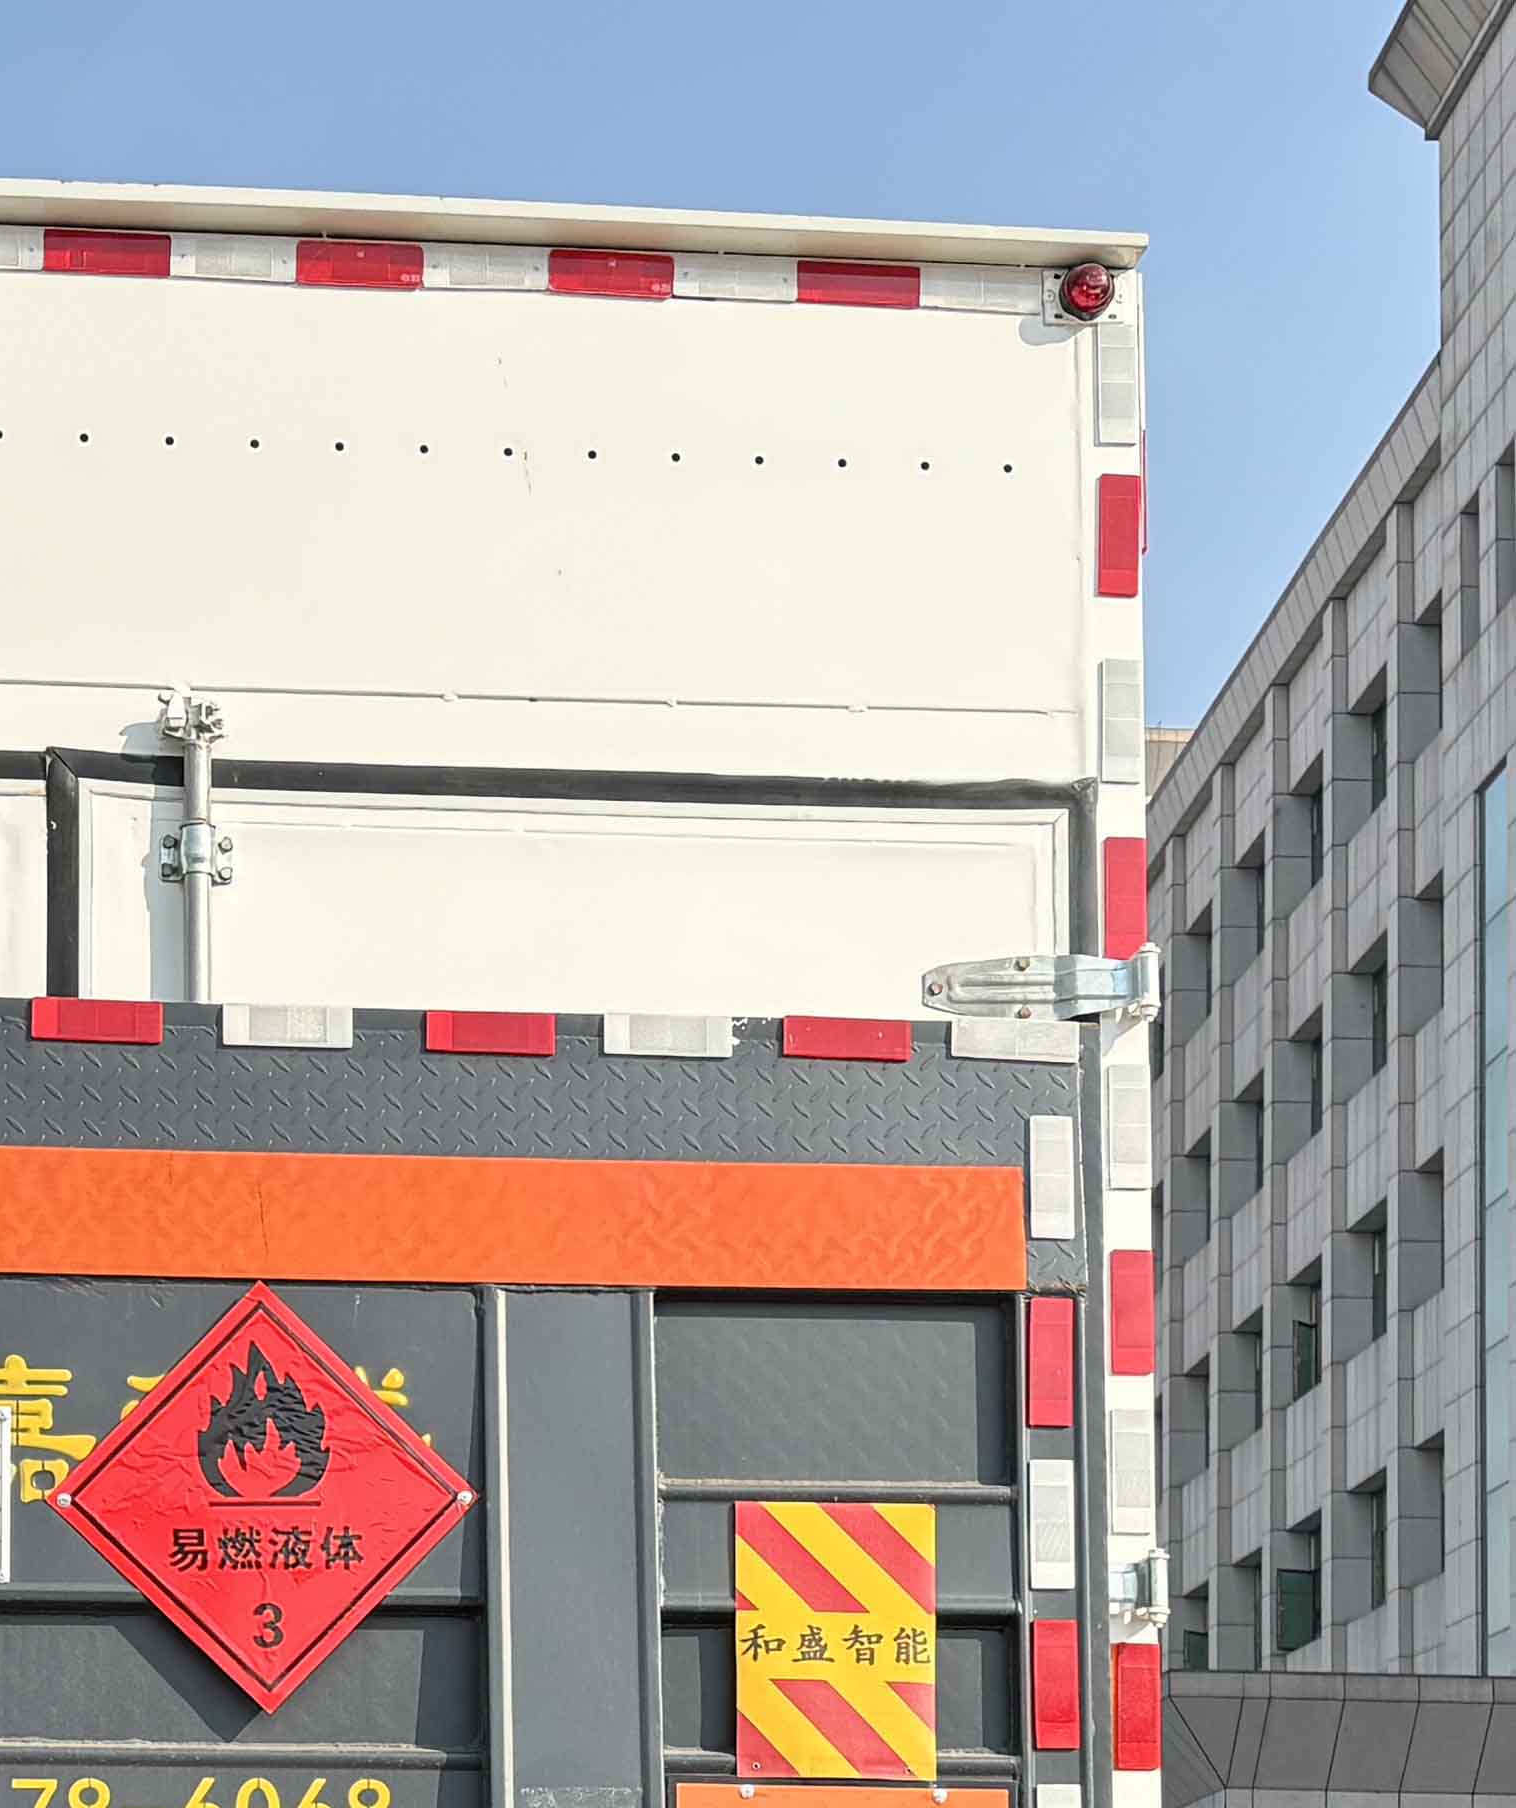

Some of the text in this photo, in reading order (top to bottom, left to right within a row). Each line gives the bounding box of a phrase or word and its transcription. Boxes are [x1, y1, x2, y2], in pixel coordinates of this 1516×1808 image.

[168, 1527, 365, 1573] 易燃液体
[251, 1602, 286, 1649] 3
[739, 1623, 932, 1667] 和盛智能
